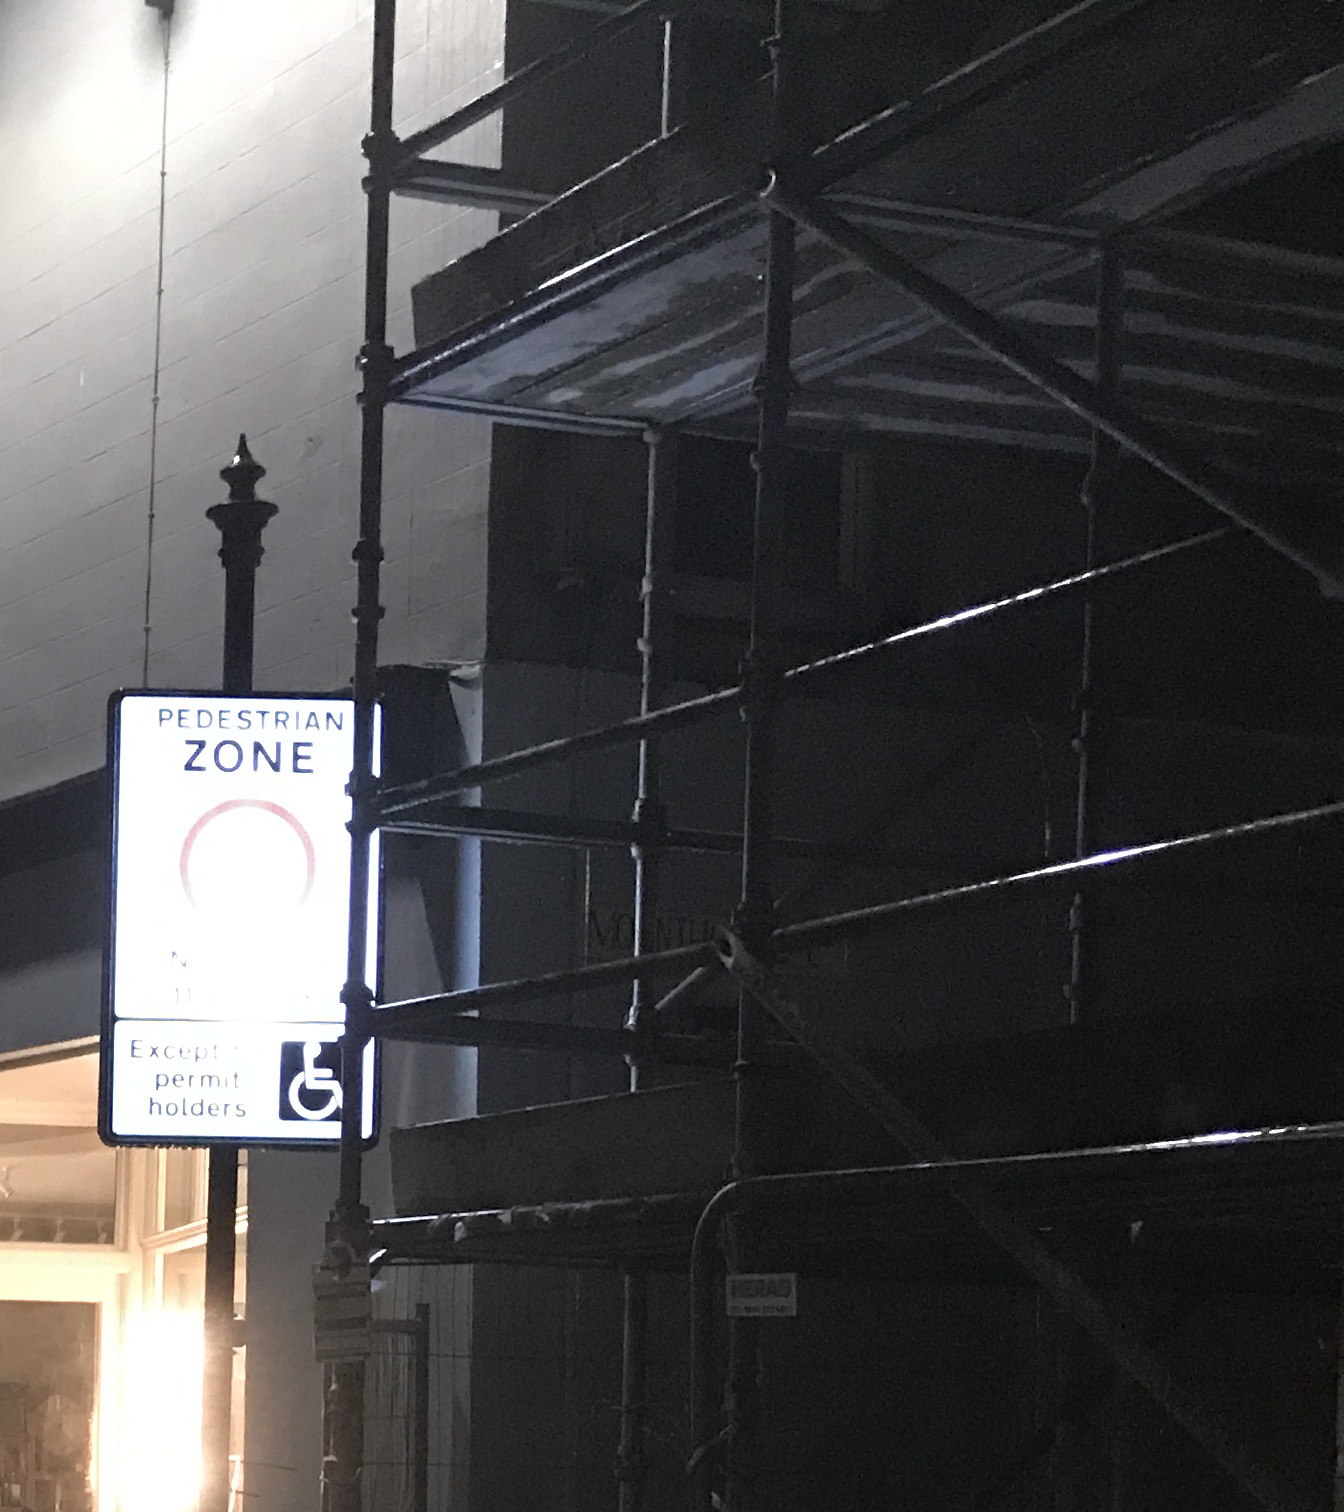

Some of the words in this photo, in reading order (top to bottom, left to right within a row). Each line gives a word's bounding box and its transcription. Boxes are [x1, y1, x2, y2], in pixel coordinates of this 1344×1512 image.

[158, 708, 344, 731] PEDESTRIAN
[184, 739, 315, 773] ZONE
[130, 1040, 219, 1062] Except
[155, 1071, 240, 1090] permit
[148, 1097, 247, 1118] holders
